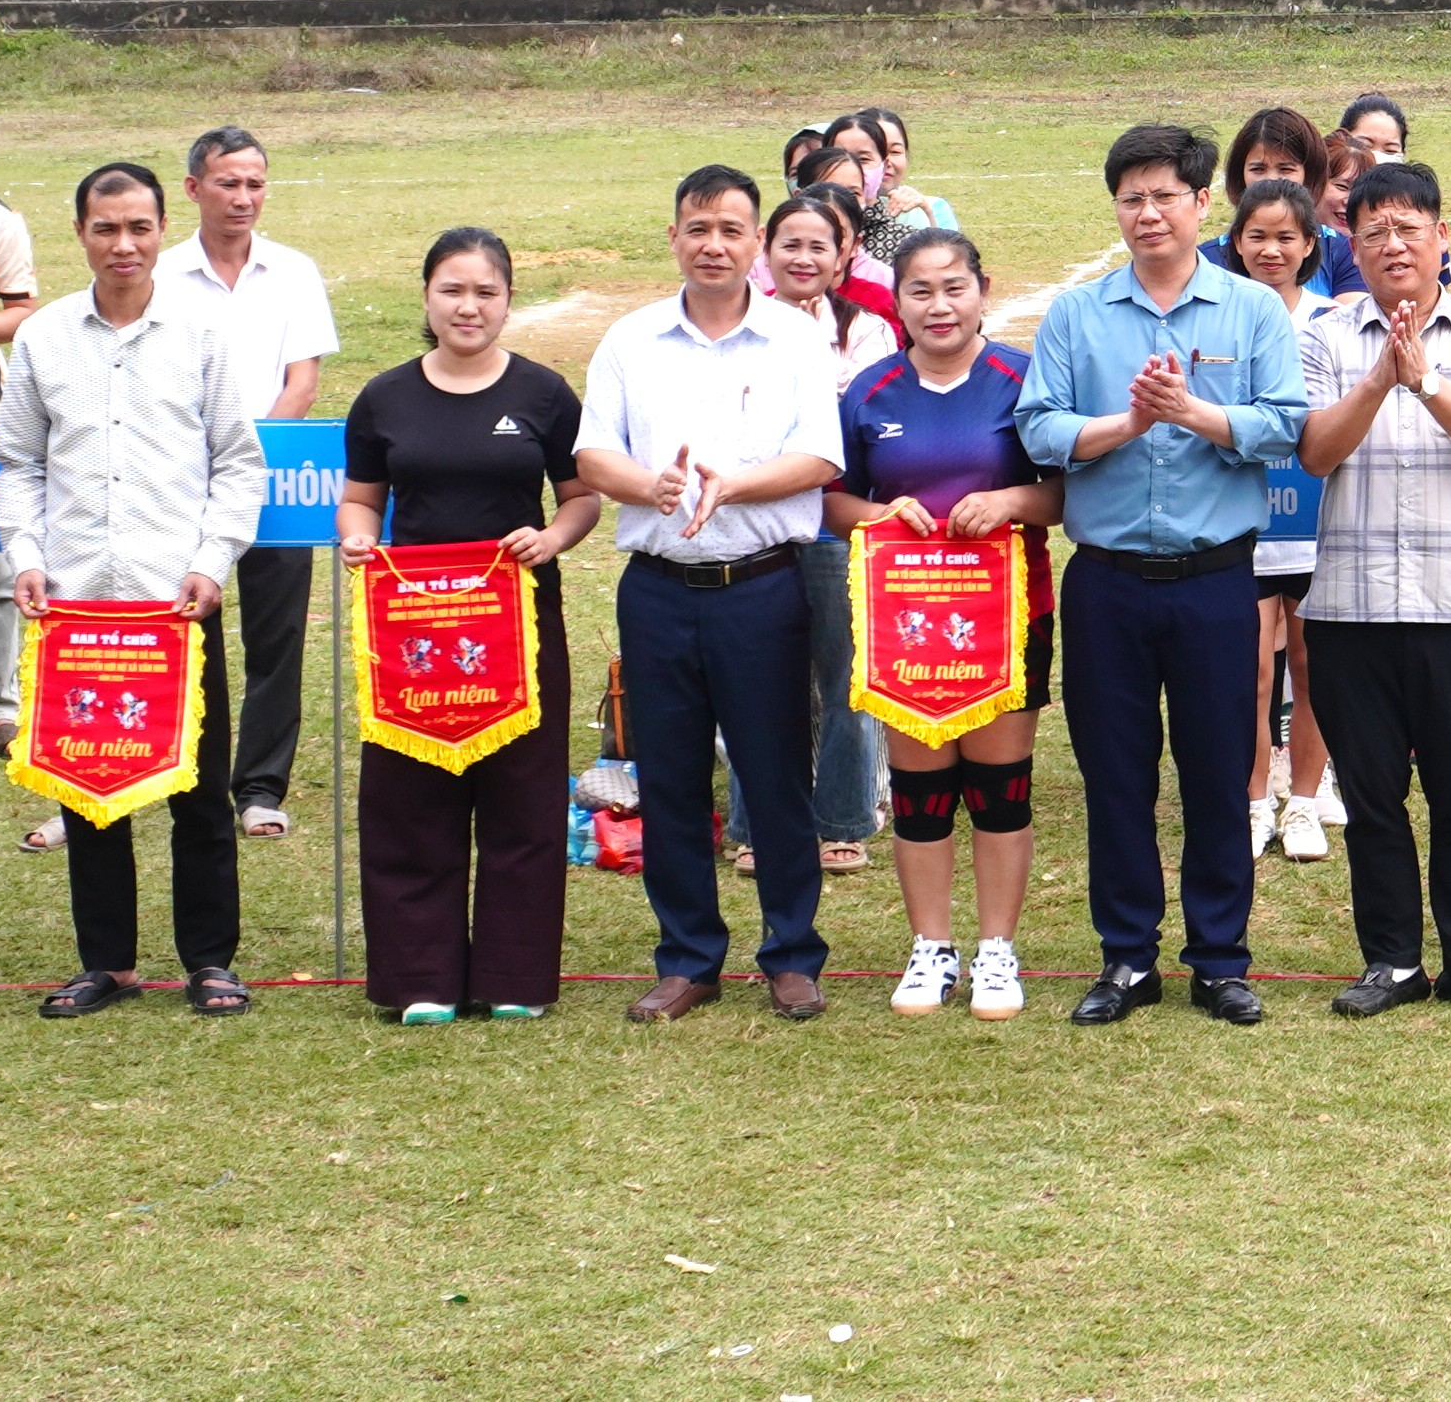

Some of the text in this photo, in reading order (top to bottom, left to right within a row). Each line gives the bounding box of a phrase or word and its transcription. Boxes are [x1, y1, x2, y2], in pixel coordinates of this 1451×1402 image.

[262, 460, 346, 507] THÔN
[895, 550, 980, 565] BAN TỔ CHỨC
[428, 575, 448, 591] TỔ
[70, 630, 158, 646] BAN TỔ CHỨC
[892, 659, 987, 686] Lưu niệm
[398, 684, 500, 713] Lưu niệm
[55, 735, 154, 762] Lưu niệm
